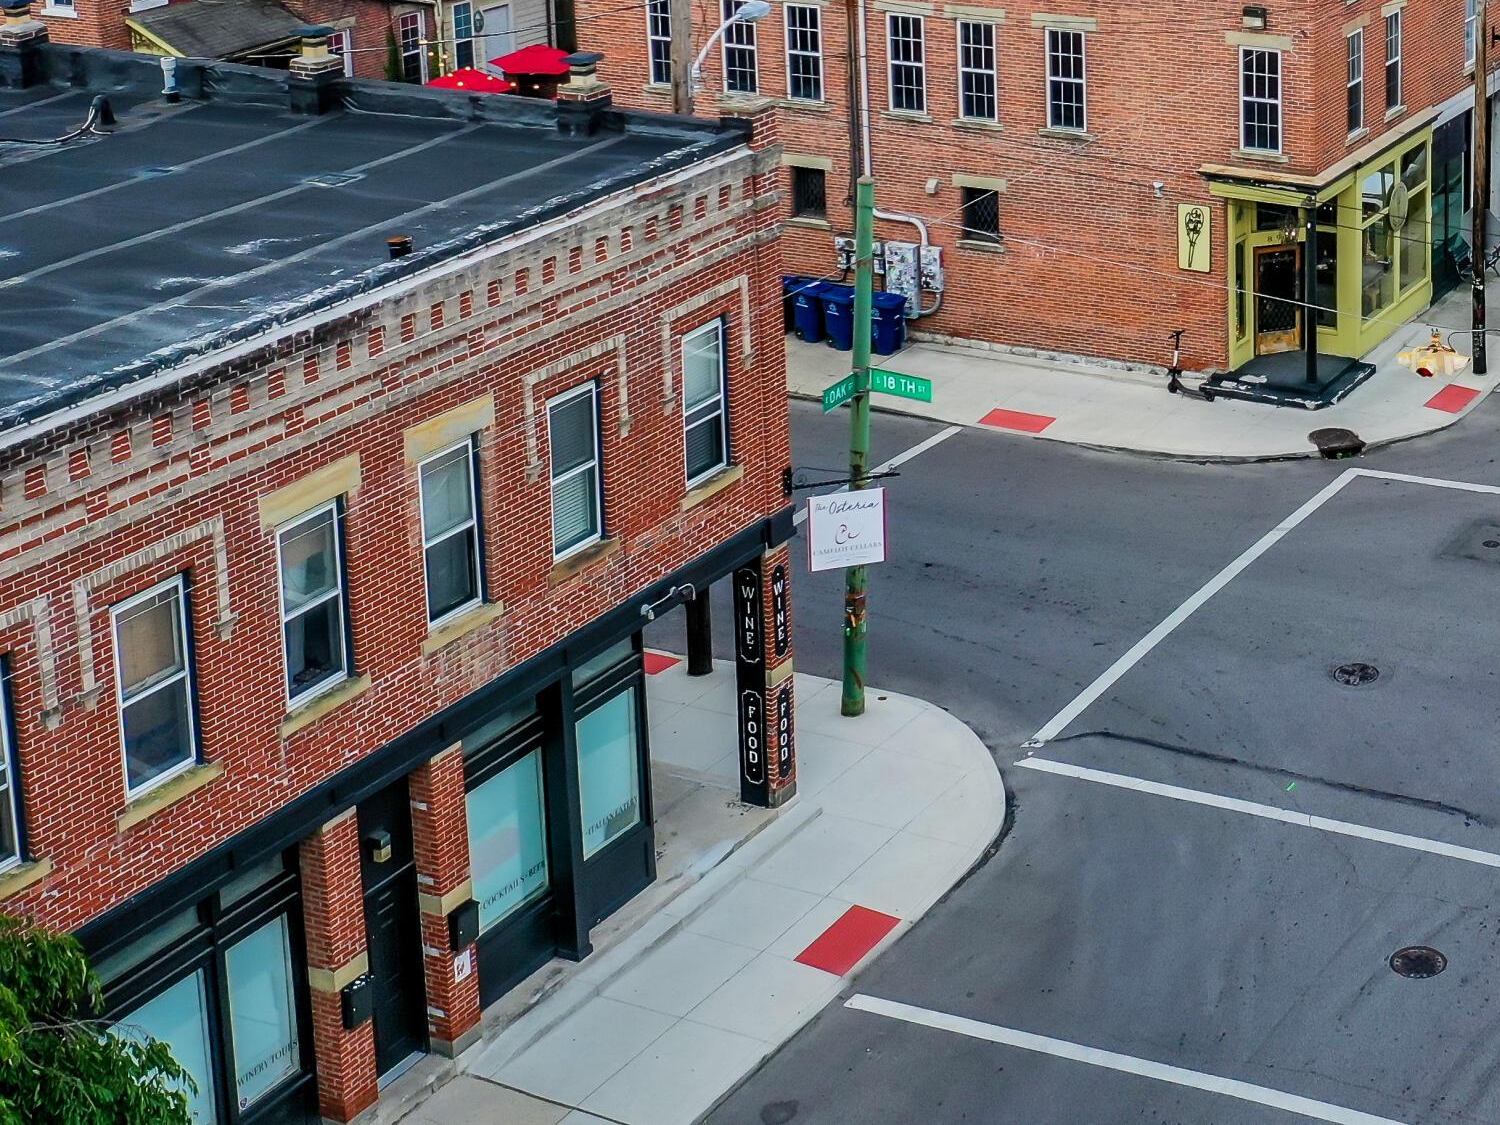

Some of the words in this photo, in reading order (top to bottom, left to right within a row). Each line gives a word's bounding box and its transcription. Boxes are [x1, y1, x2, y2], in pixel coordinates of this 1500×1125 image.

[829, 383, 847, 404] OAK
[883, 375, 896, 389] 18
[900, 378, 916, 394] TH
[917, 385, 926, 393] ST
[828, 501, 880, 515] Osteria
[813, 546, 848, 556] CAMELOT
[850, 541, 882, 551] CELLARS
[741, 585, 755, 645] WINE
[773, 578, 785, 640] WINE
[748, 705, 758, 764] FOOD
[780, 702, 788, 762] FOOD
[482, 876, 525, 910] COCKTAILS
[237, 1060, 269, 1087] WINERY
